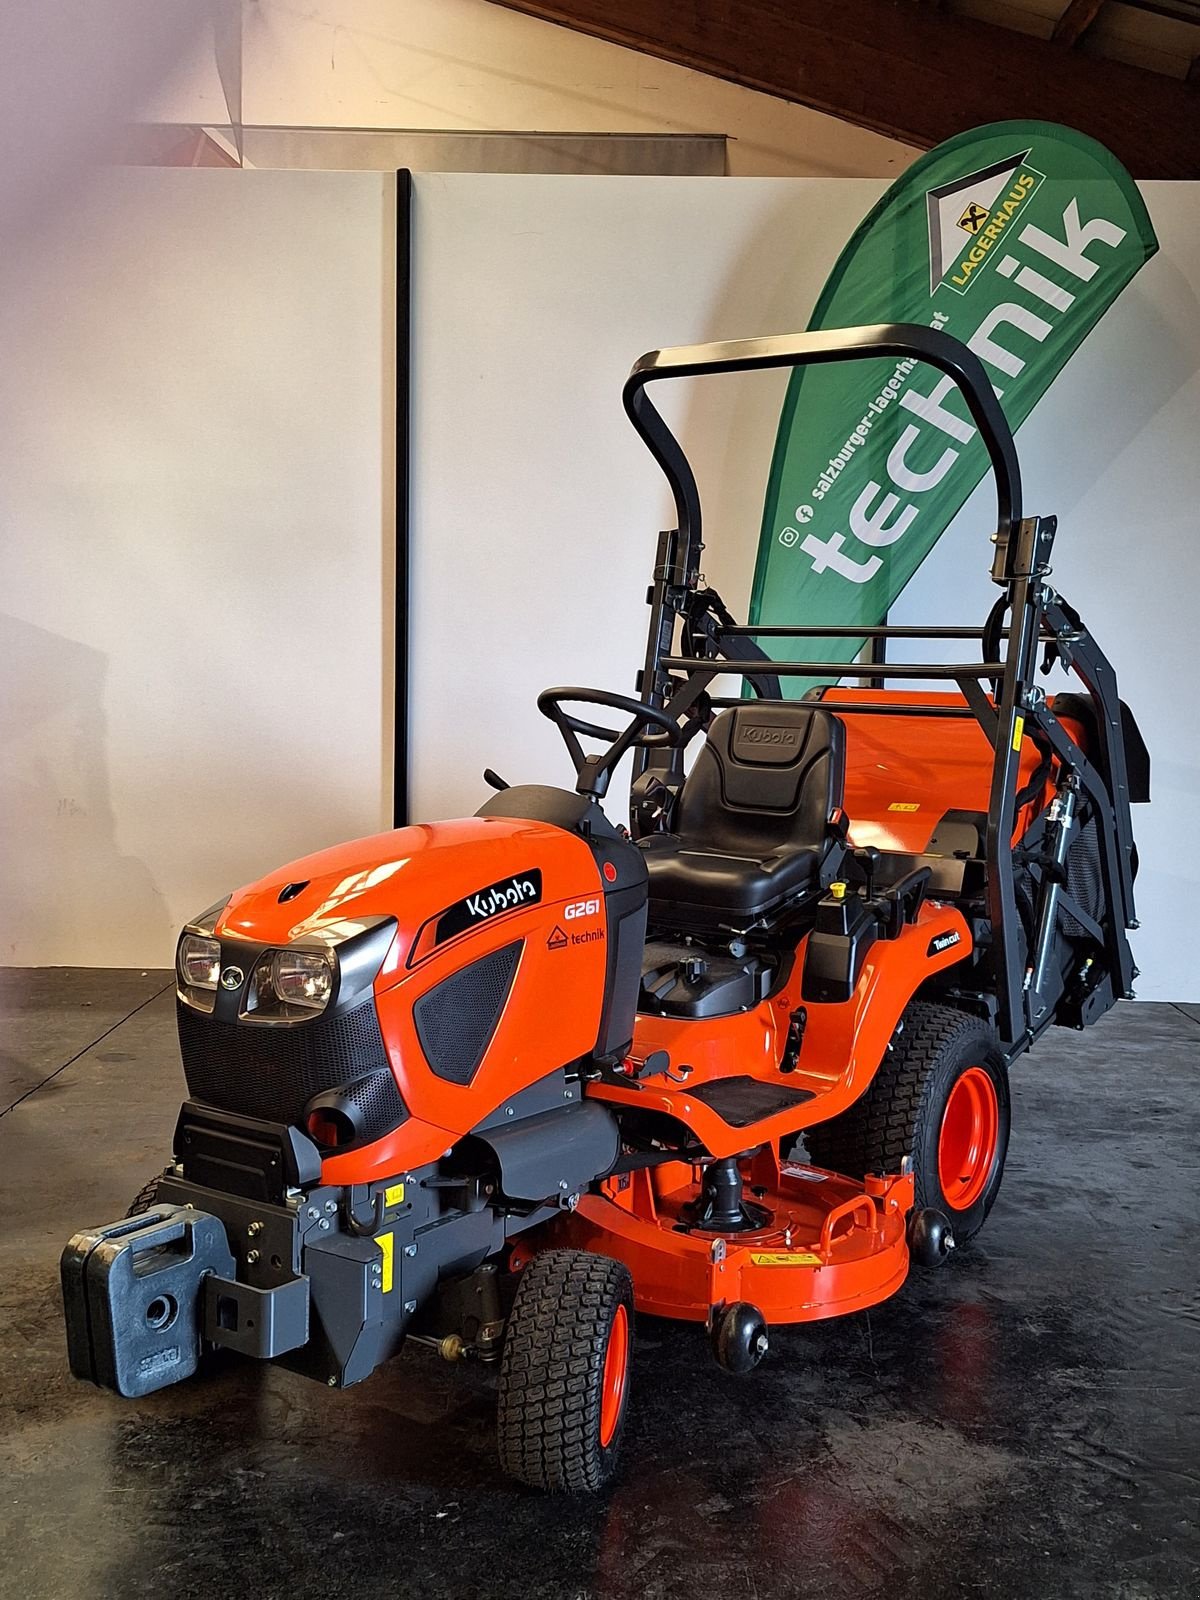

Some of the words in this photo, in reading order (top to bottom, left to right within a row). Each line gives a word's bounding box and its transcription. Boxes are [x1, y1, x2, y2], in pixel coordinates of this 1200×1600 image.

[951, 173, 1035, 286] LAGERHAUS
[799, 197, 1127, 584] technik
[742, 727, 797, 745] Kubota
[466, 878, 537, 917] Kubota
[564, 899, 600, 920] G261
[571, 928, 605, 945] technik
